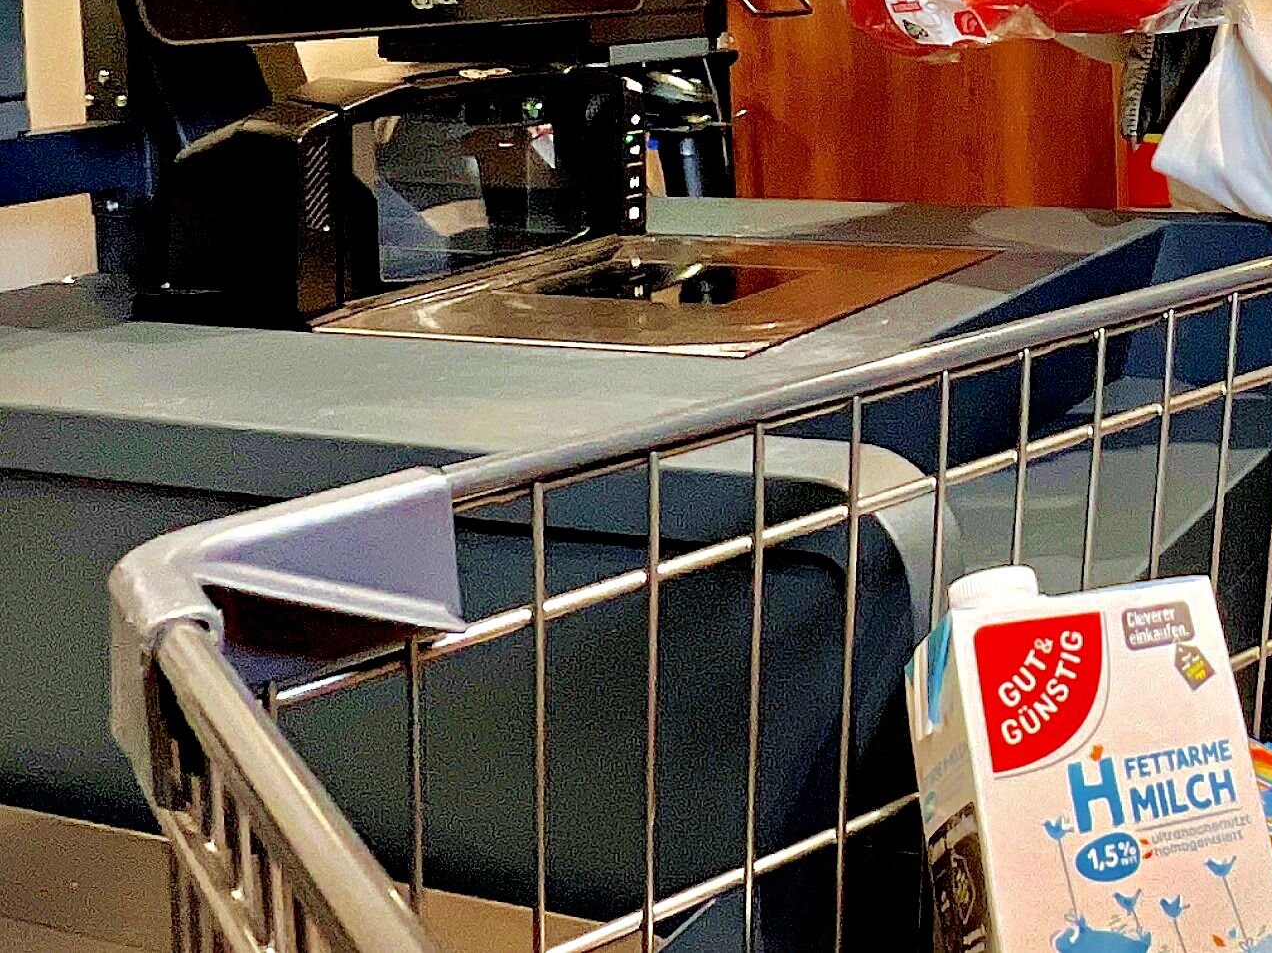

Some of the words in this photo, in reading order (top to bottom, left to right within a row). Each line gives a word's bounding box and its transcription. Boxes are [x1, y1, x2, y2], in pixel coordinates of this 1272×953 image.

[1126, 607, 1176, 628] Cleverer
[1001, 630, 1084, 746] GÜNSTIG
[1123, 739, 1233, 781] FETTARME
[1067, 756, 1125, 834] H
[1129, 768, 1237, 824] MILCH
